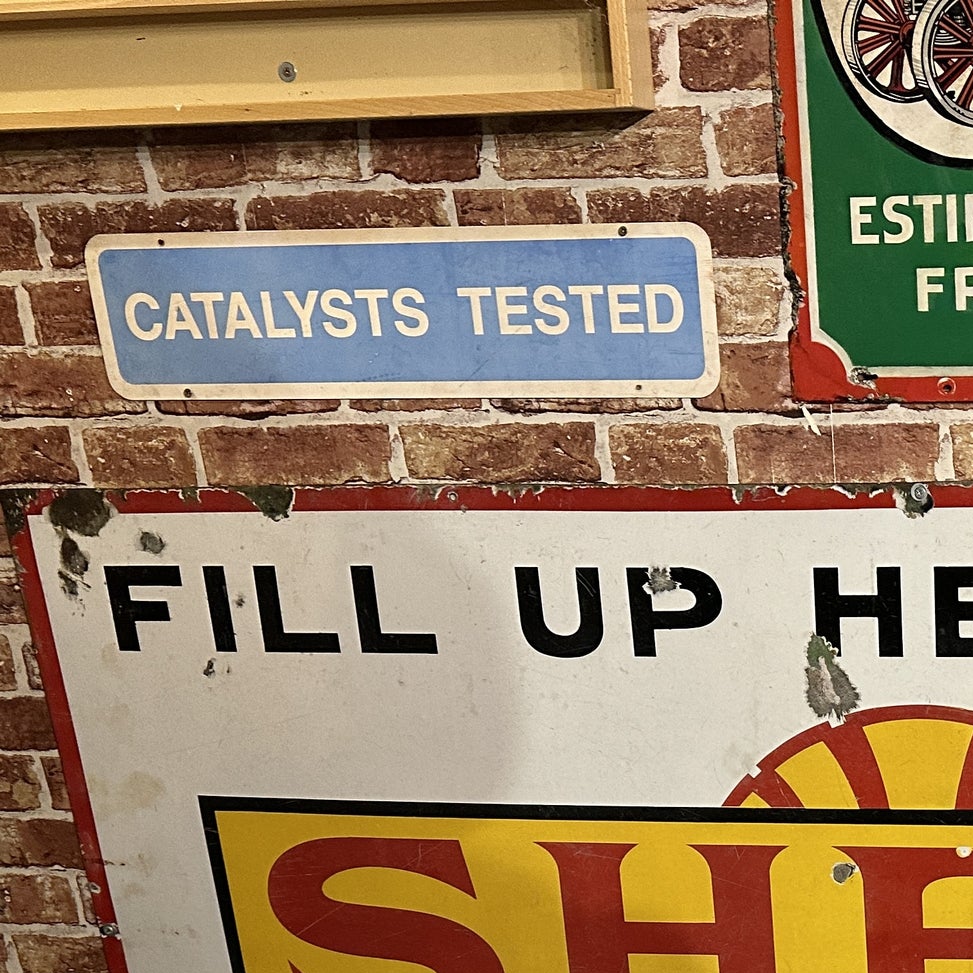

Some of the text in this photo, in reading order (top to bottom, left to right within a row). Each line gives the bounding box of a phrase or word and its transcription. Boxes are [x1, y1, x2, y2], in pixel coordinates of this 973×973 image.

[124, 284, 685, 342] CATALYSTS TESTED
[103, 564, 439, 655] FILL
[514, 564, 724, 659] UP
